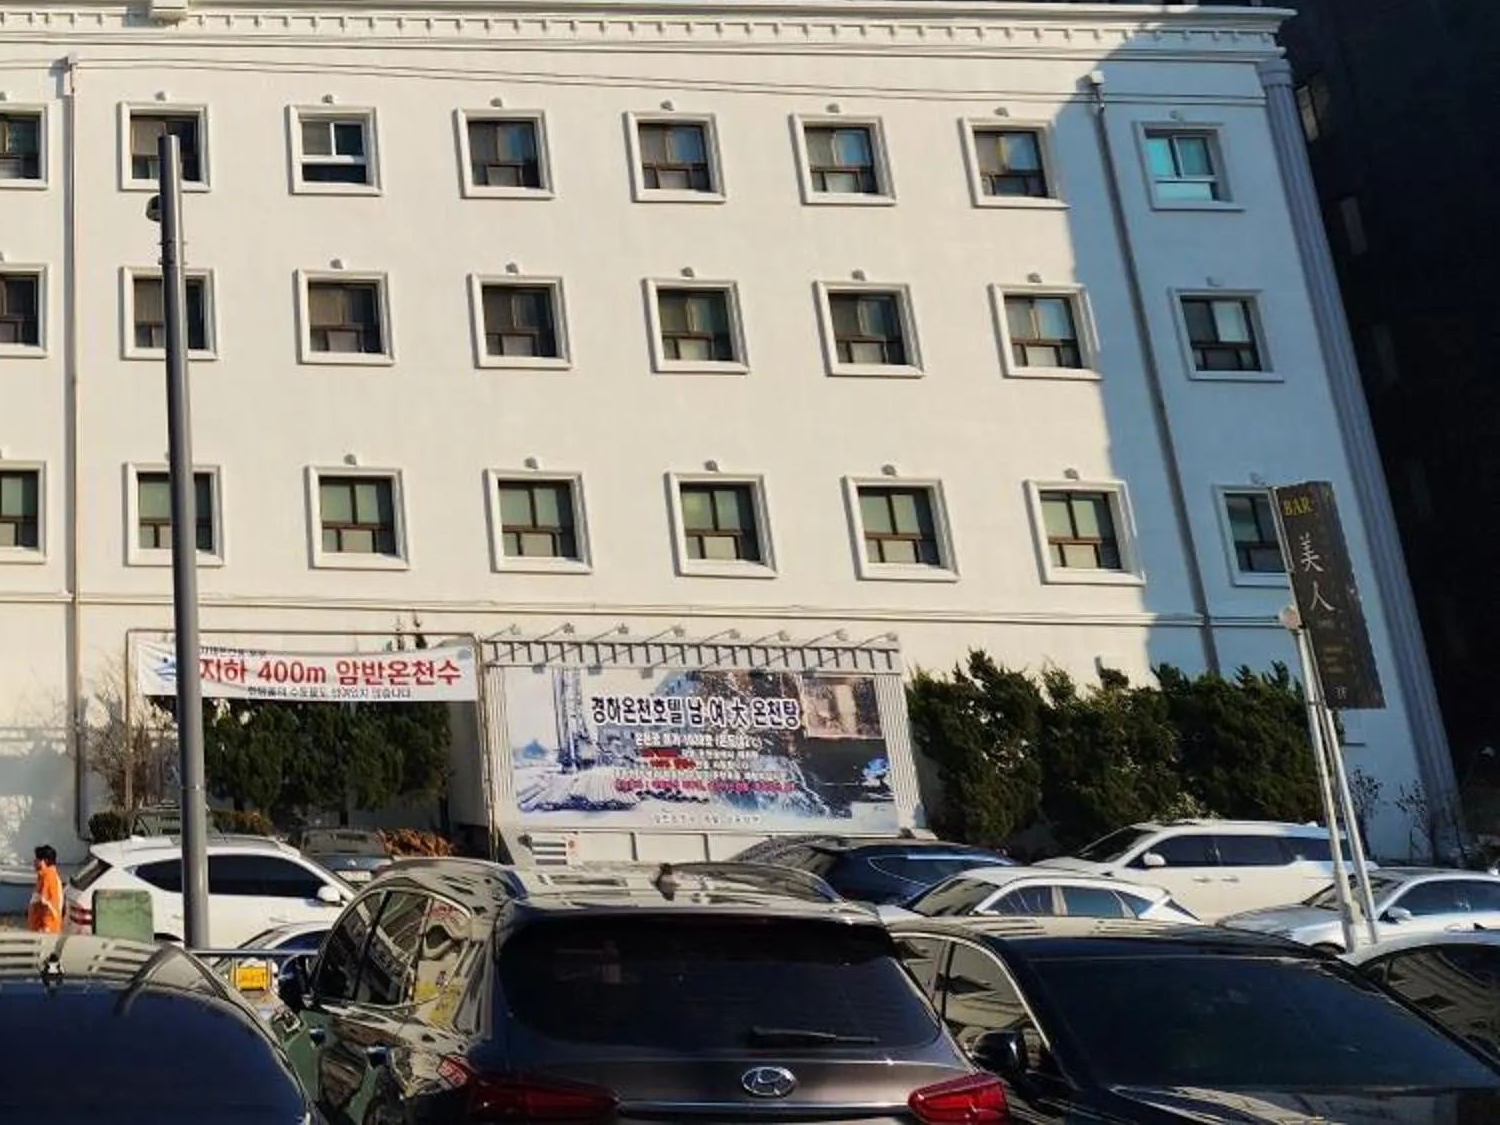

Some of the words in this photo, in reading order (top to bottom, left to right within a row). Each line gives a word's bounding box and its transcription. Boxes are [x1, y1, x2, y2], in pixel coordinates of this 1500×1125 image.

[1283, 496, 1313, 516] BAR
[1299, 530, 1337, 612] 美人
[200, 658, 248, 684] 지하
[257, 660, 327, 684] 400m
[336, 660, 461, 686] 암반온천수
[590, 696, 683, 725] 경하온천호텔
[751, 698, 800, 728] 온천탕
